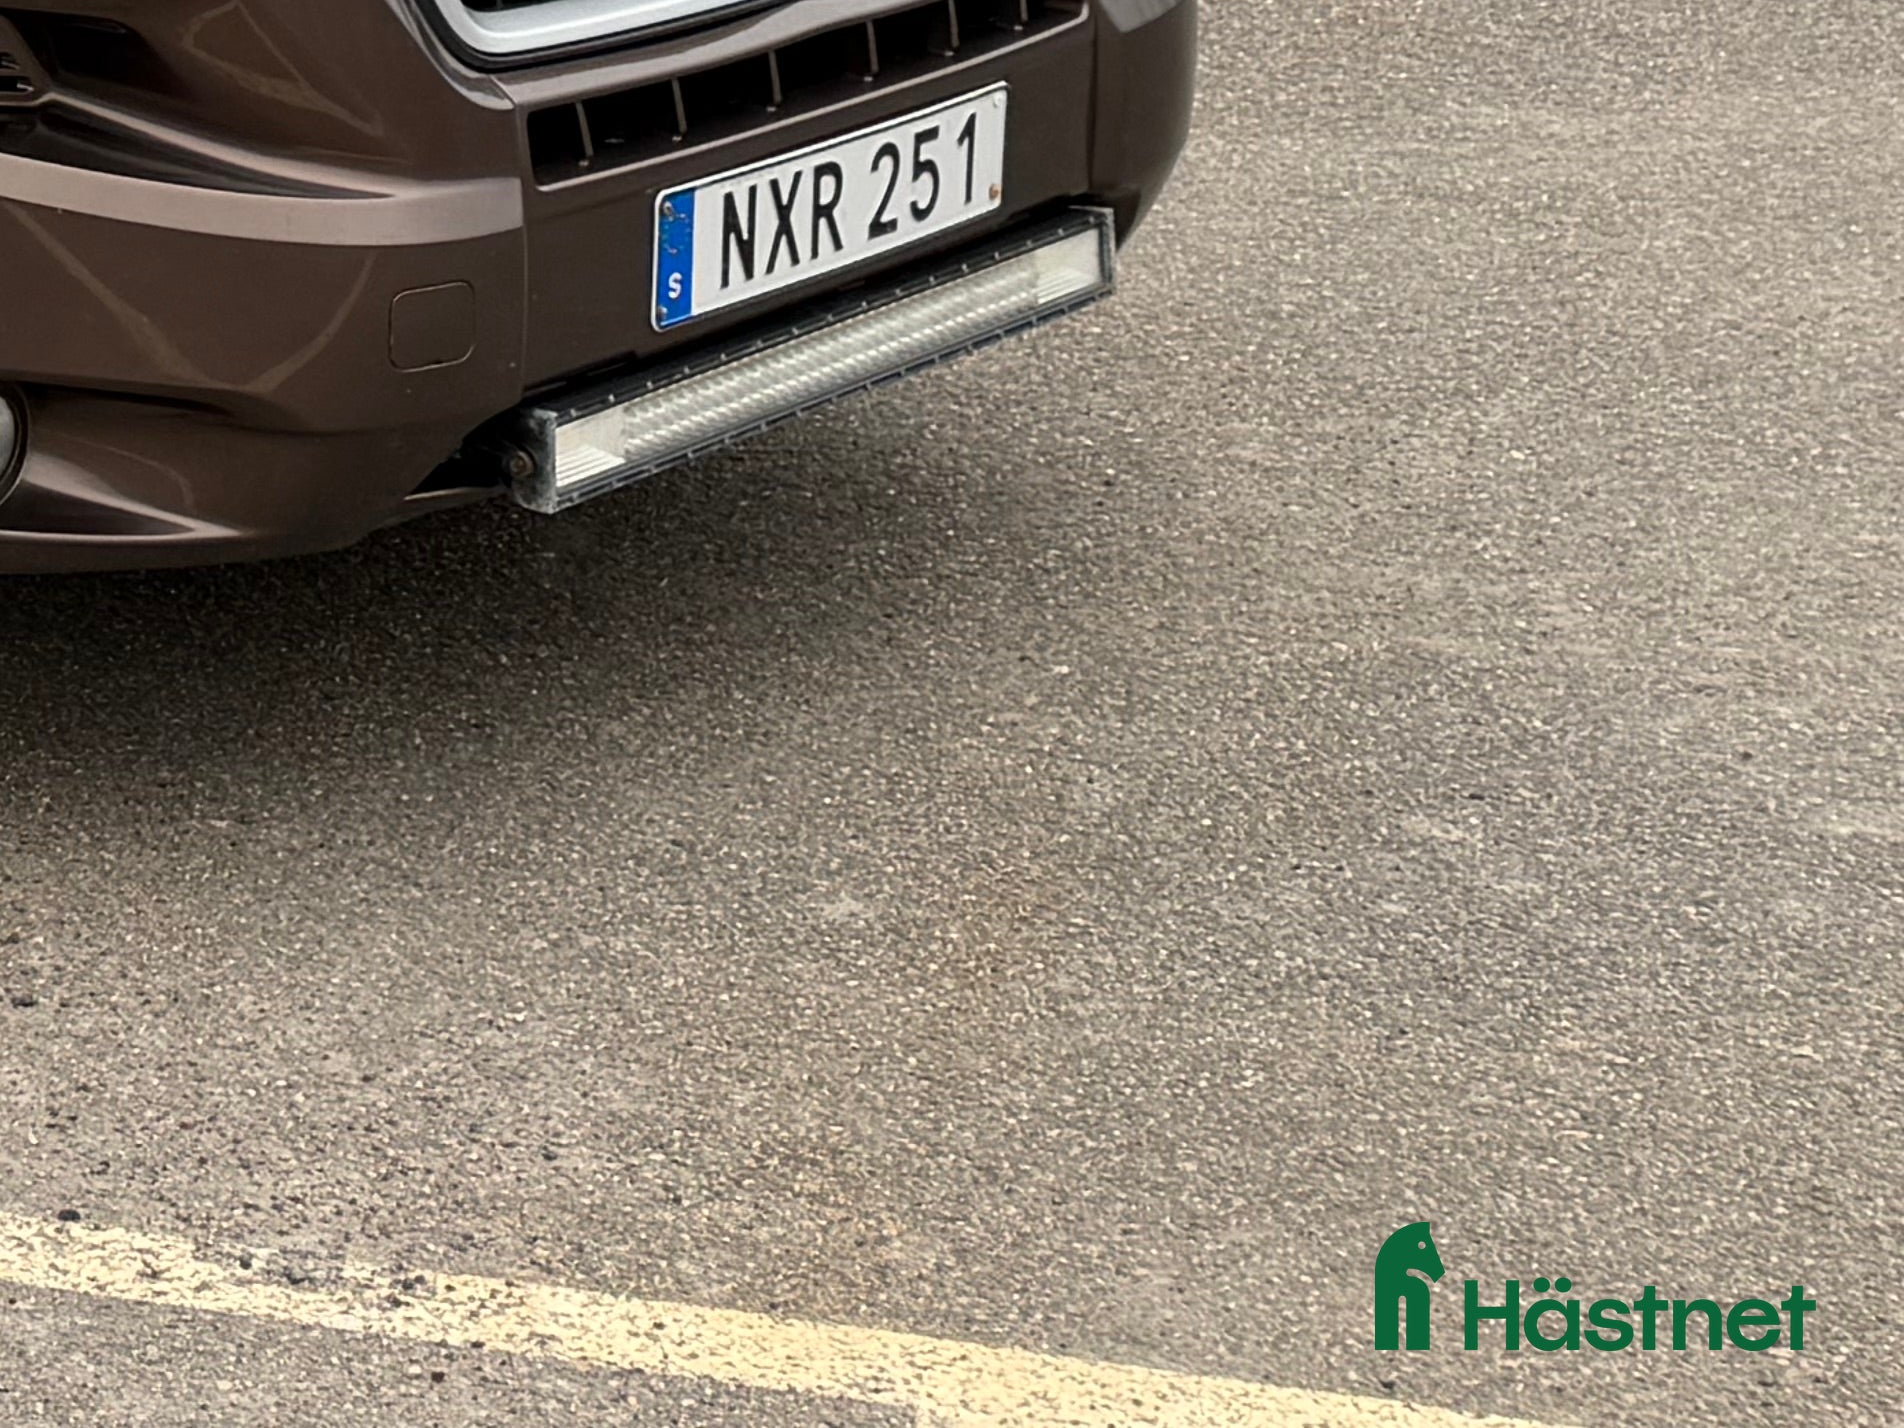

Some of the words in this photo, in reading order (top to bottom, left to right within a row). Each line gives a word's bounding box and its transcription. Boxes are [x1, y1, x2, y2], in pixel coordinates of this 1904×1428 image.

[718, 160, 844, 290] NXR
[866, 111, 979, 241] 251
[666, 271, 683, 298] S
